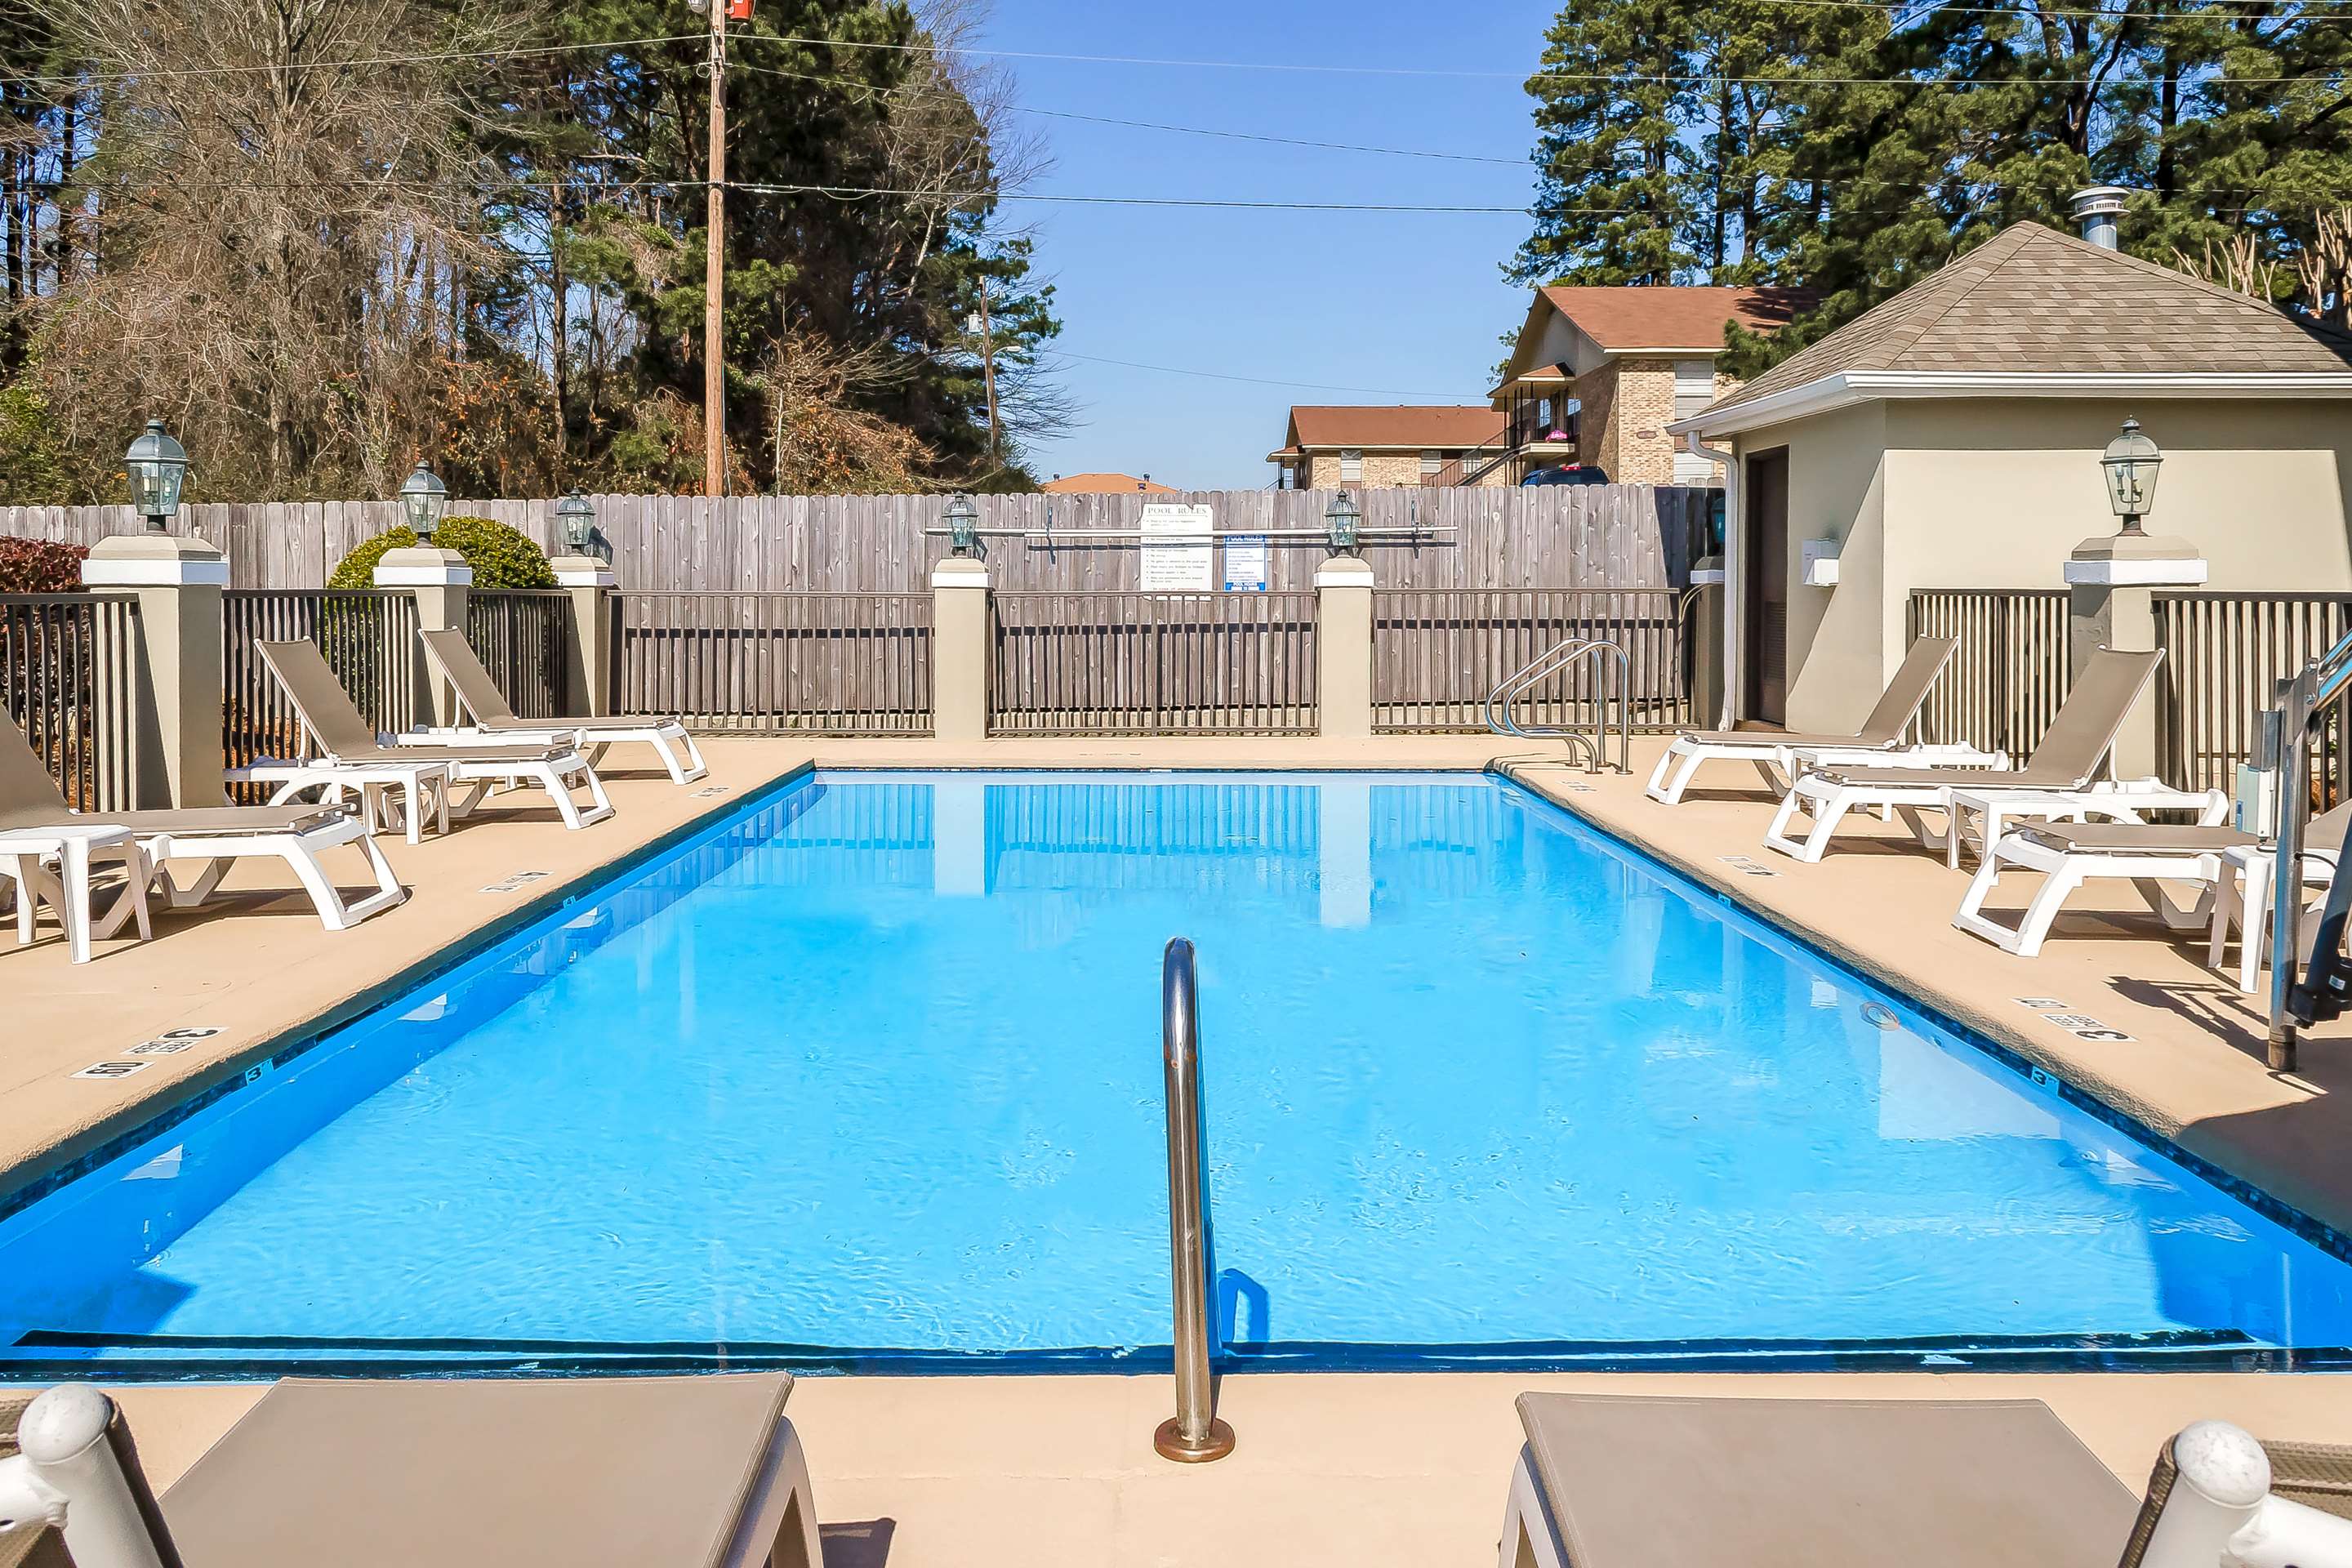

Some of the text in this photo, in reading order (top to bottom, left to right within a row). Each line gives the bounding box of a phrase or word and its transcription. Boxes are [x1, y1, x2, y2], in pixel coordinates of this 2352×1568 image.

[163, 1029, 219, 1039] 3
[2075, 1030, 2129, 1040] 3
[129, 1040, 170, 1054] DEEP
[154, 1040, 194, 1053] FEET
[247, 1067, 262, 1081] 3
[2033, 1071, 2047, 1085] 3
